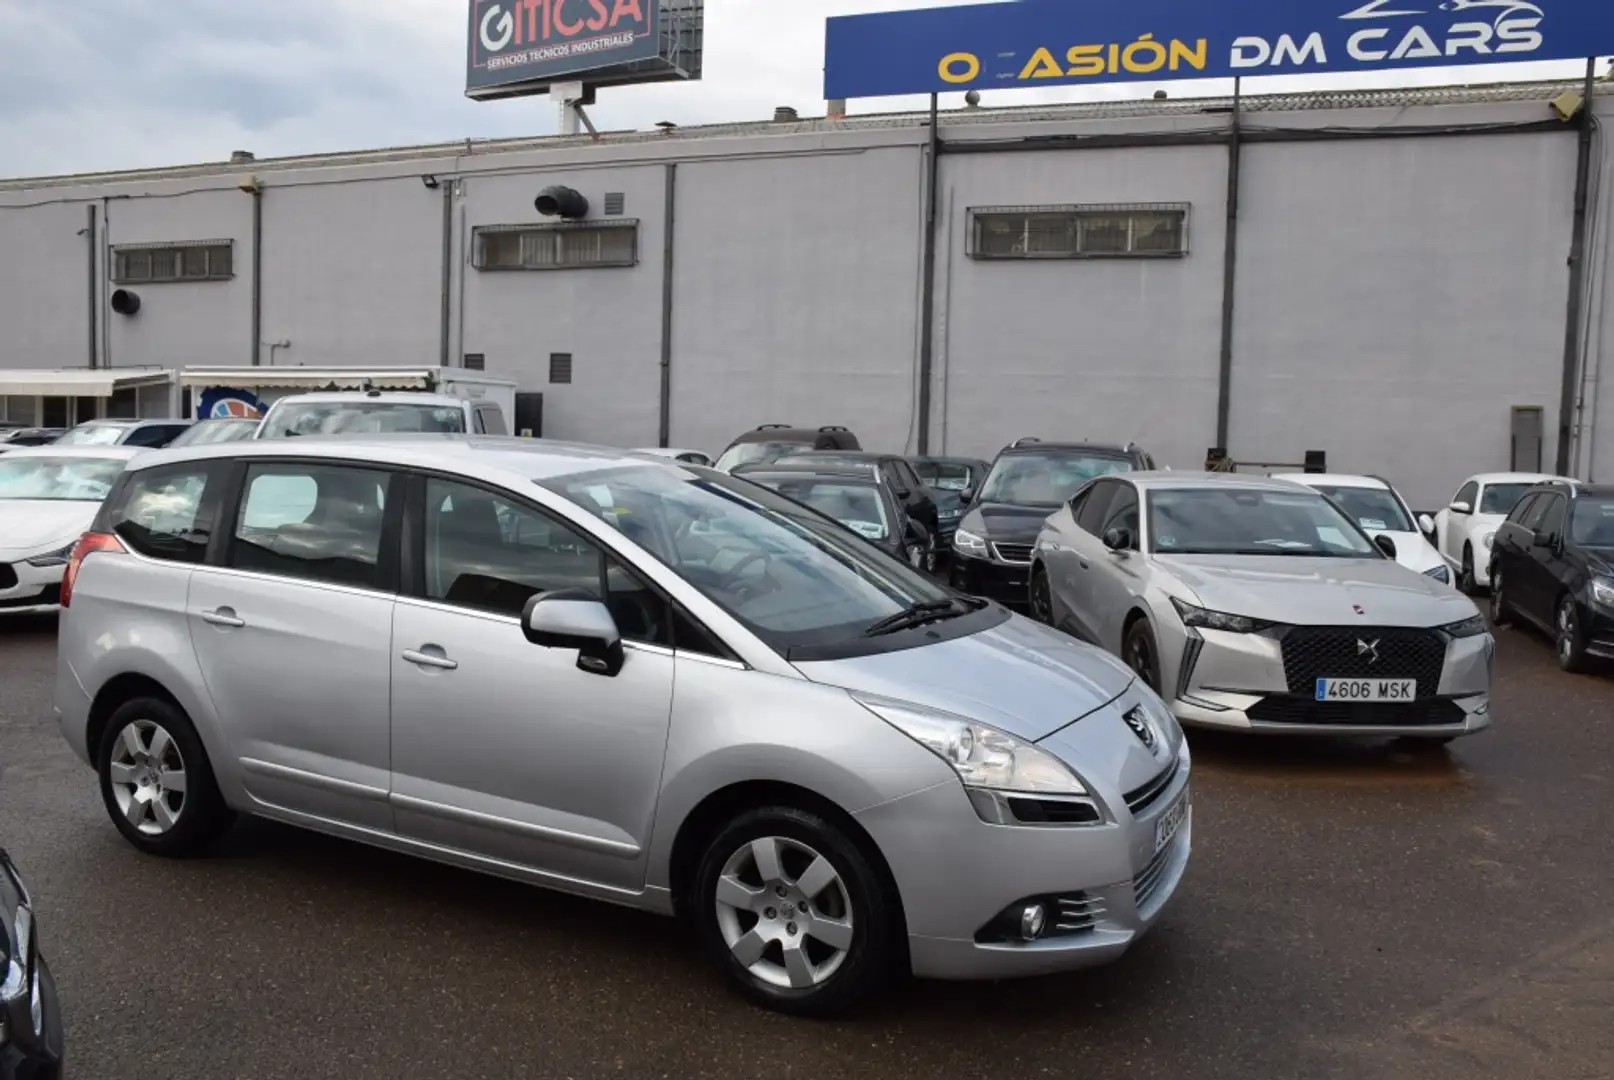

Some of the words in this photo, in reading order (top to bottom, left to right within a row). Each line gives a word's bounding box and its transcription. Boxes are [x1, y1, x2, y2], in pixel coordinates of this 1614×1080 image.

[487, 53, 528, 69] SERVICIOS
[530, 45, 570, 60] TECNICOS
[571, 33, 634, 52] INDUSTRIALES
[937, 33, 1207, 83] OASIÓN
[1229, 32, 1327, 67] DM
[1346, 17, 1544, 61] CARS
[1328, 681, 1371, 698] 4606
[1378, 682, 1411, 698] MSK
